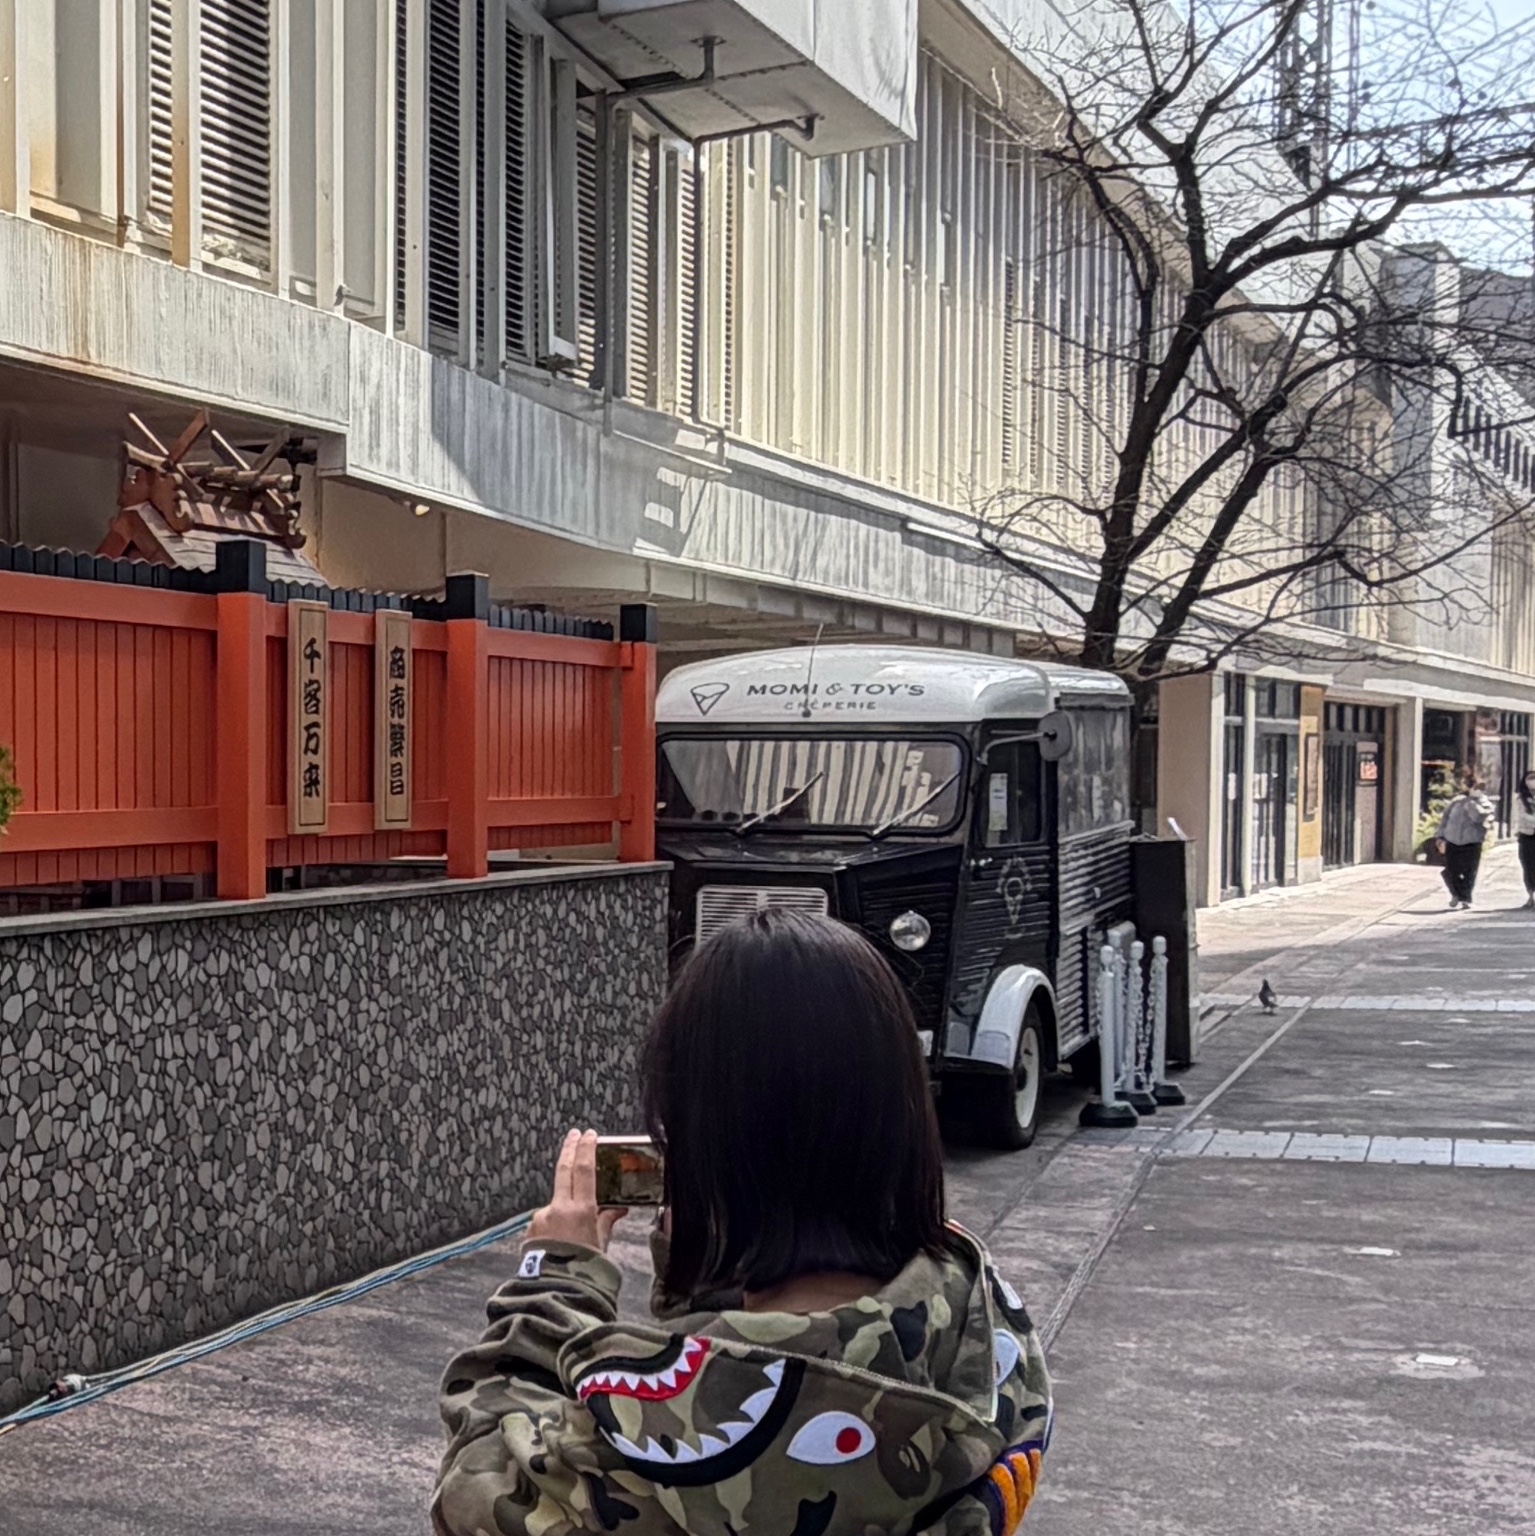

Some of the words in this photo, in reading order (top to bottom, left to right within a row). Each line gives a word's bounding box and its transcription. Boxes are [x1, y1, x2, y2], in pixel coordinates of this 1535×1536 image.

[303, 637, 322, 798] 千客万来
[747, 683, 818, 696] MOMI
[825, 682, 844, 696] &
[850, 683, 925, 696] TOY'S
